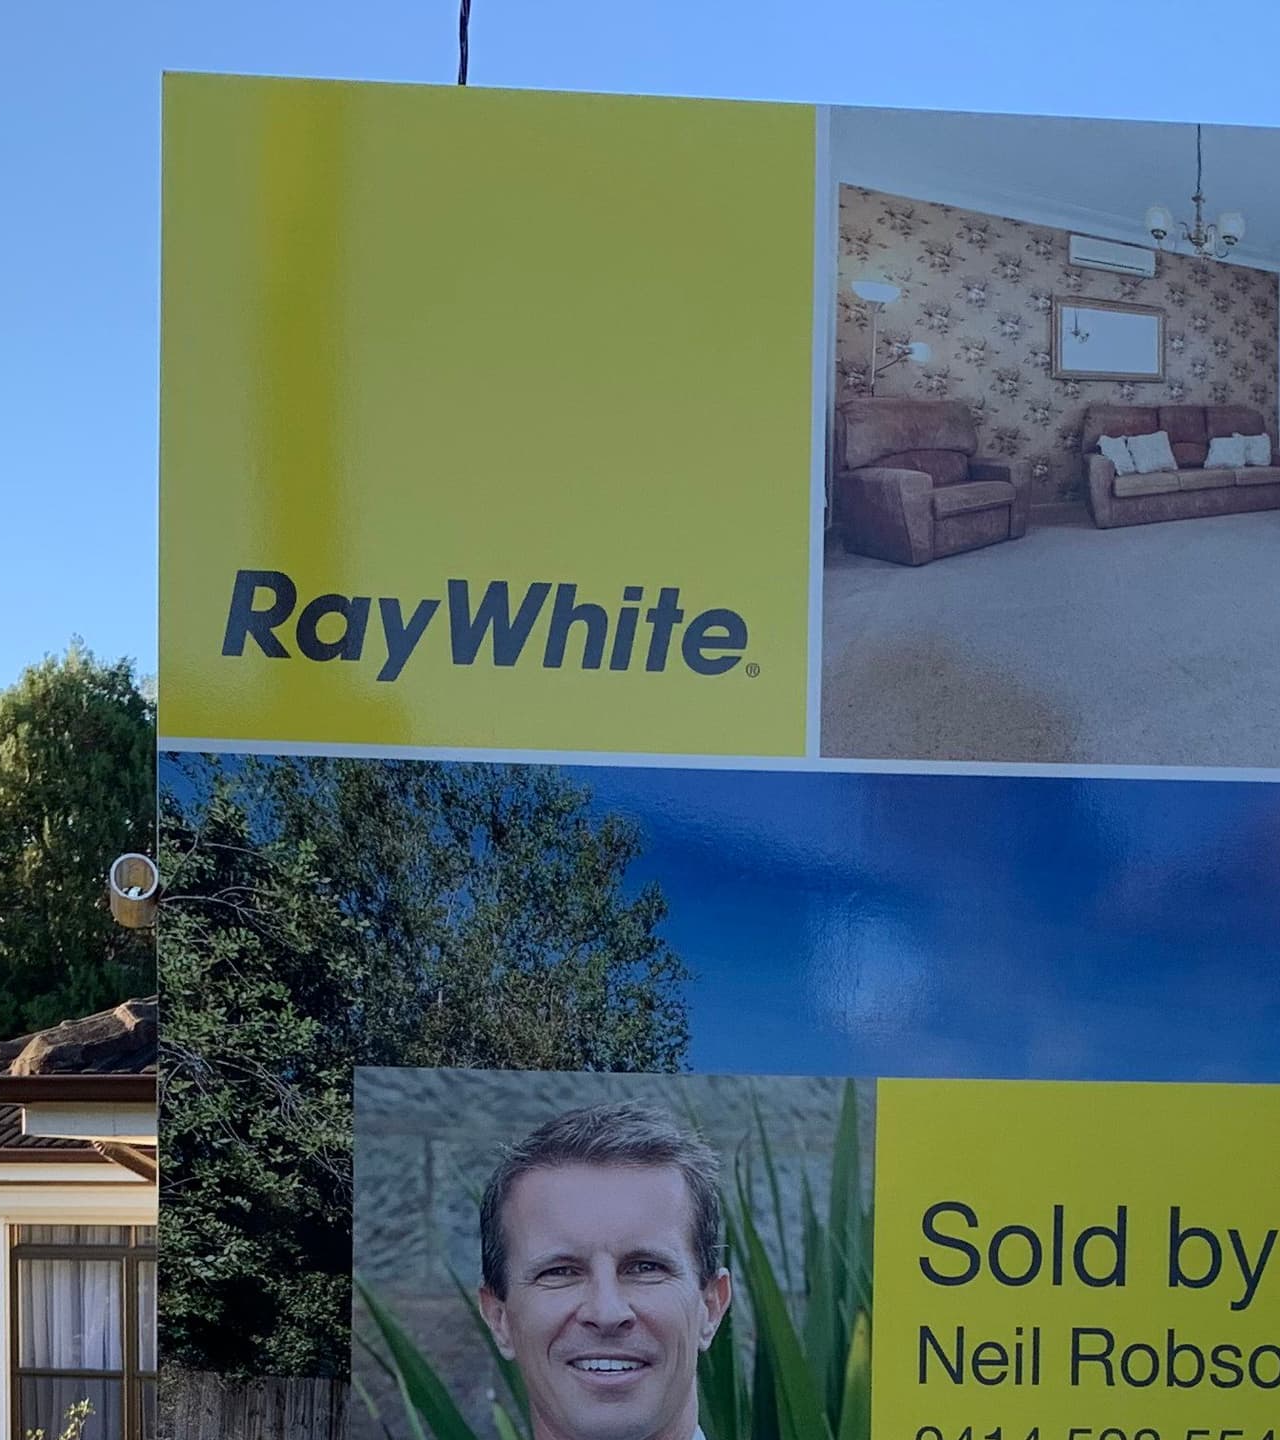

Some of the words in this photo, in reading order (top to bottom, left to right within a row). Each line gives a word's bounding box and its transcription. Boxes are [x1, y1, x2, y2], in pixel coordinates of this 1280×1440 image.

[920, 1202, 1127, 1287] Sold
[1169, 1206, 1278, 1311] by
[919, 1326, 1040, 1385] Neil
